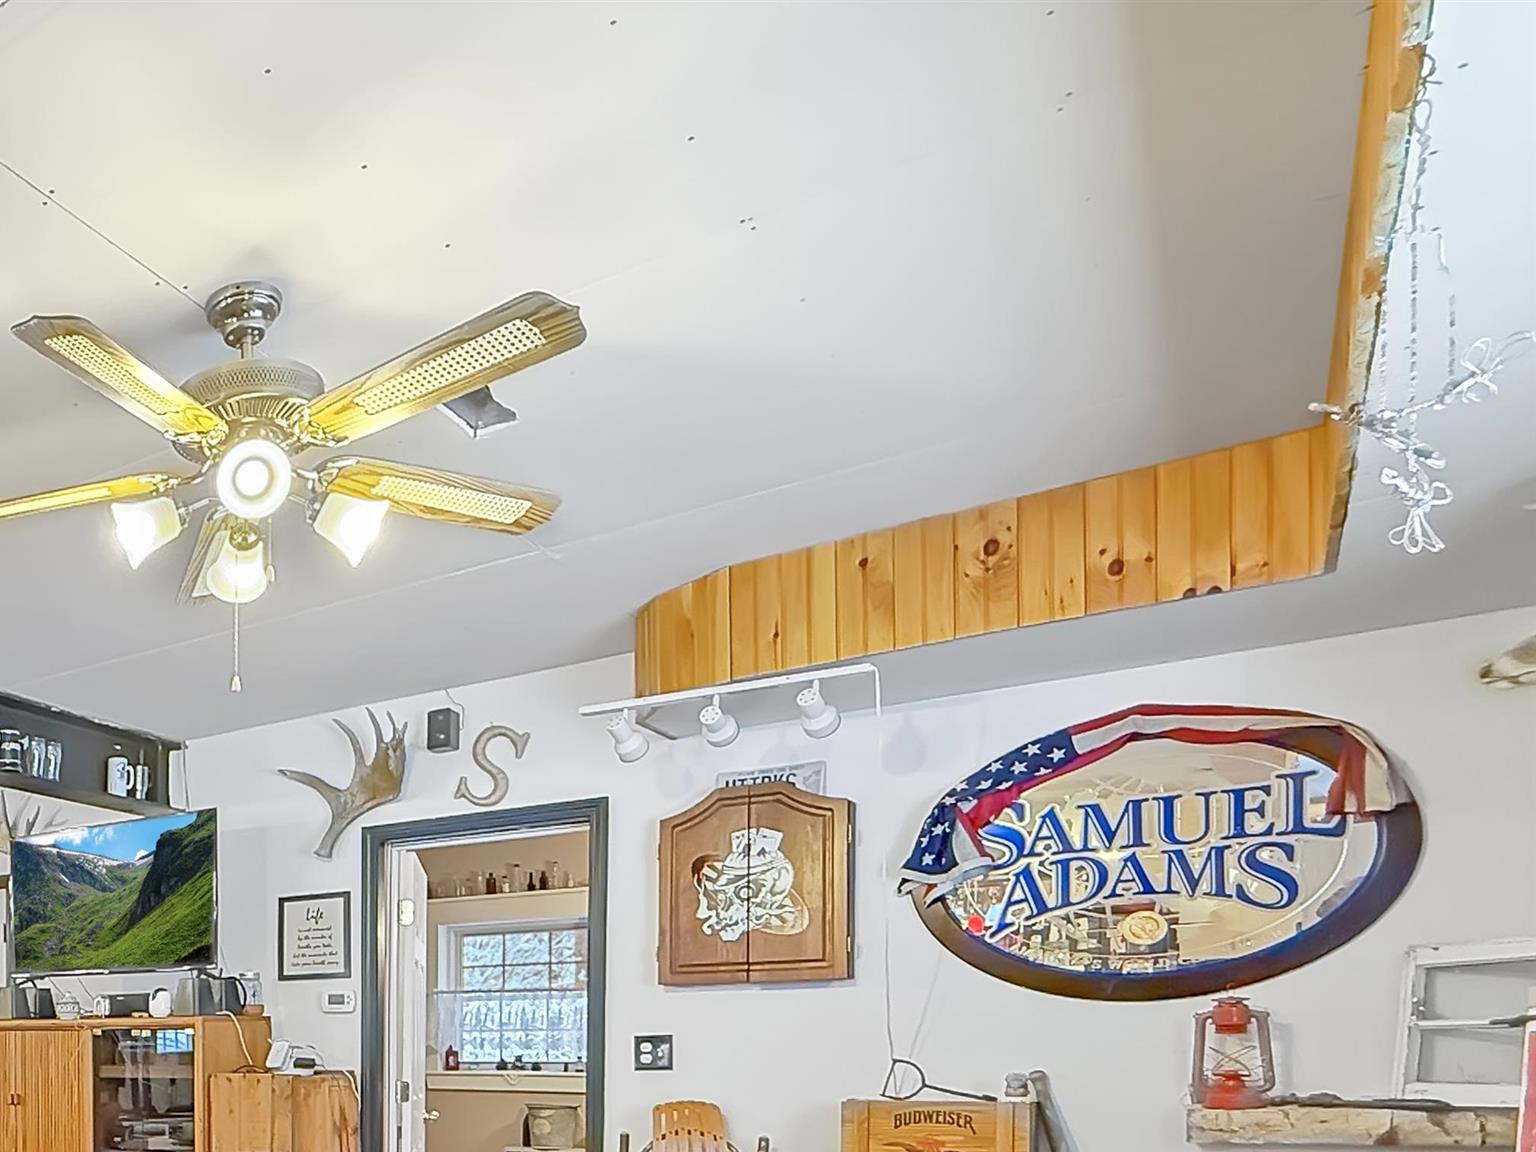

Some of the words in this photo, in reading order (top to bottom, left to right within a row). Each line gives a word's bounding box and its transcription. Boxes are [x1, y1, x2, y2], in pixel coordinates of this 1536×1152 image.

[454, 724, 531, 807] S
[977, 769, 1348, 869] SAMUEL
[987, 840, 1300, 940] ADAMS
[894, 1110, 976, 1135] BUDWEISER
